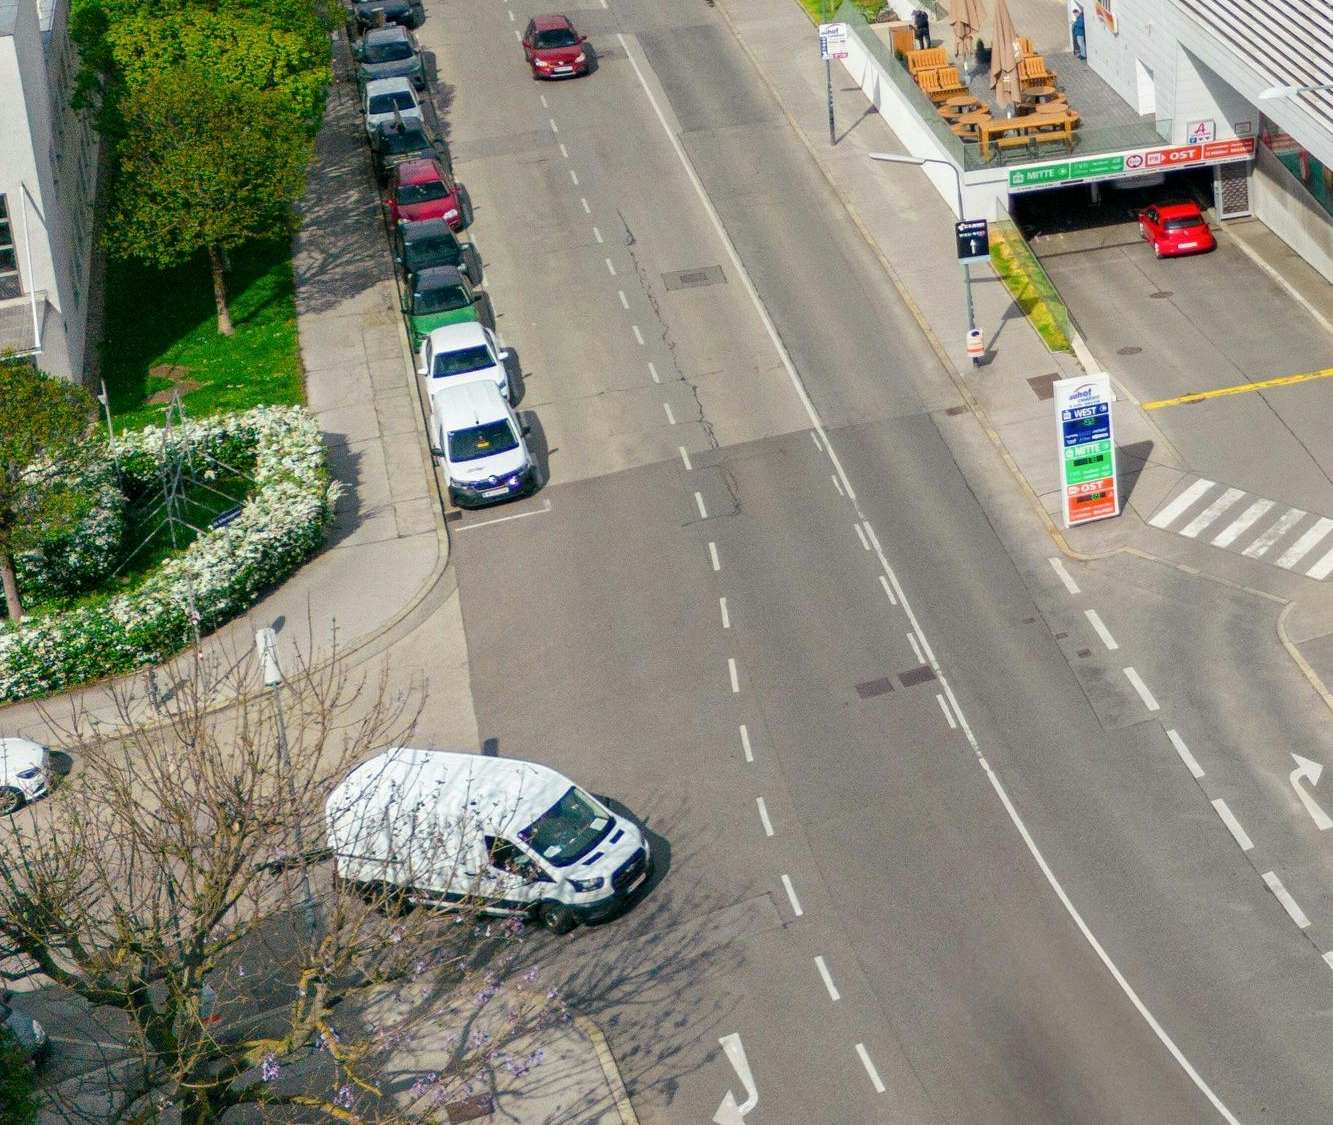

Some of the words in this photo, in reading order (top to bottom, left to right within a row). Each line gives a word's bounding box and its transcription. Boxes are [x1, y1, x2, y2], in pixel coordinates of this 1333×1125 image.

[1169, 150, 1198, 162] OST
[1026, 168, 1055, 180] MITTE
[1069, 388, 1092, 400] auhof
[1074, 407, 1097, 418] WEST
[1081, 480, 1104, 492] OST
